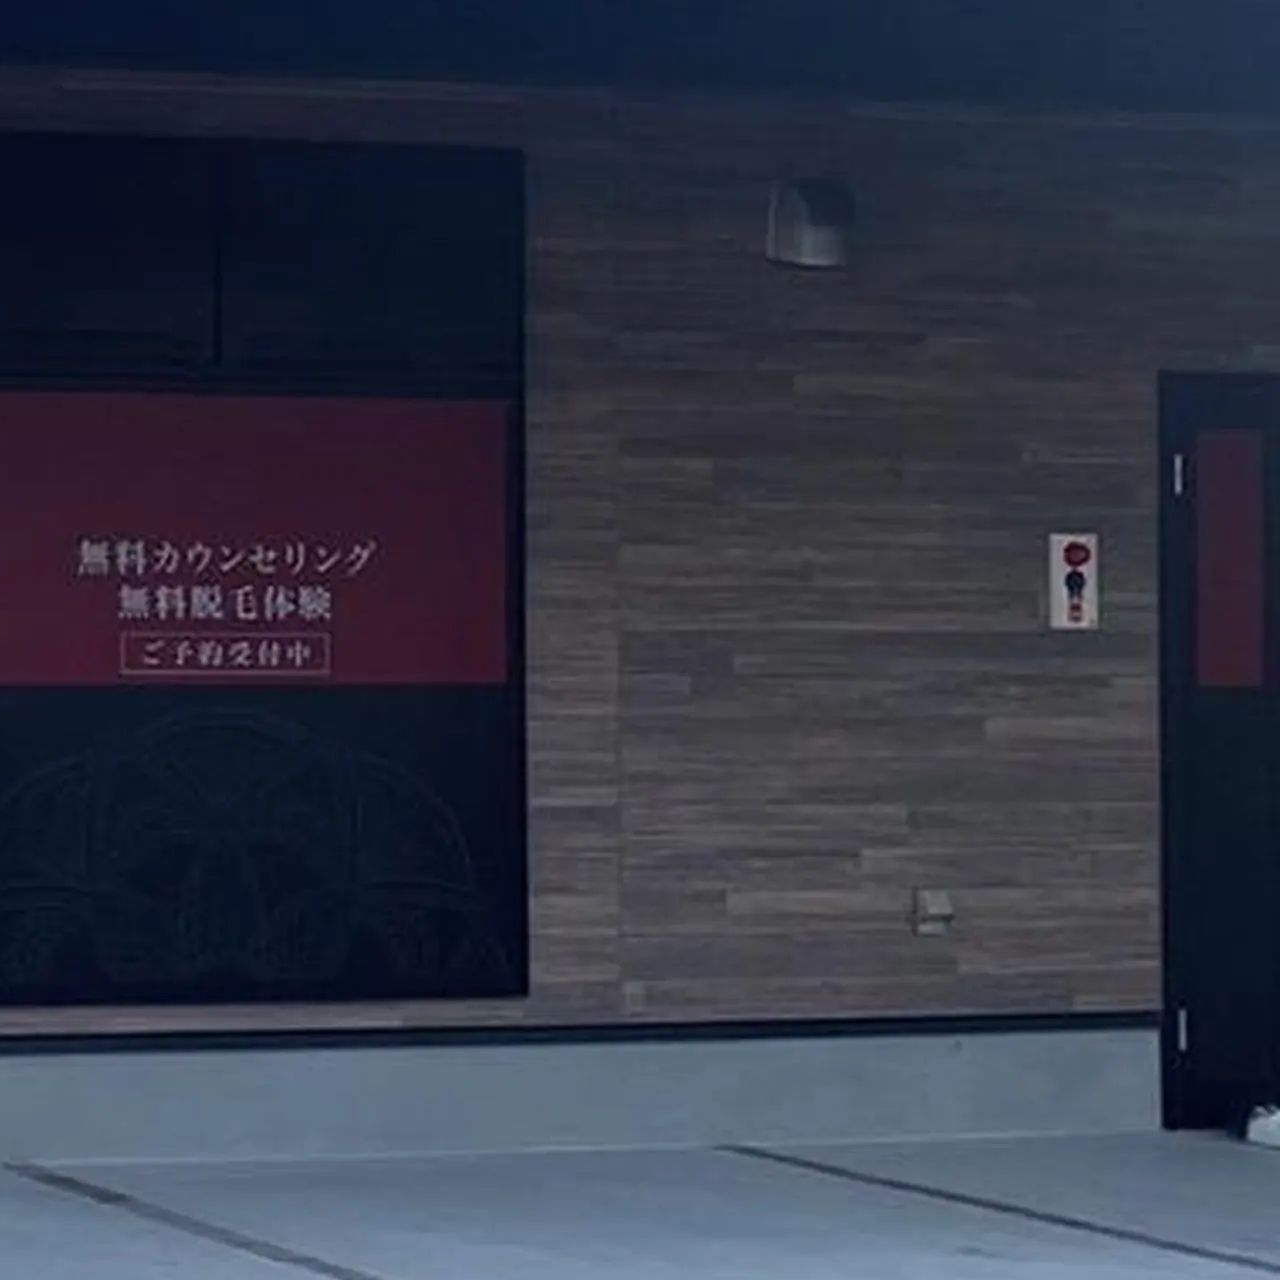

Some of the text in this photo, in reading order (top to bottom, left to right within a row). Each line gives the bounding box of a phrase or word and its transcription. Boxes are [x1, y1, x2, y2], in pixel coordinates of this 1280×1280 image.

[74, 538, 378, 577] 無料カウンセリング
[117, 584, 333, 622] 無料脱毛体験
[140, 639, 314, 669] ご予約受付中
